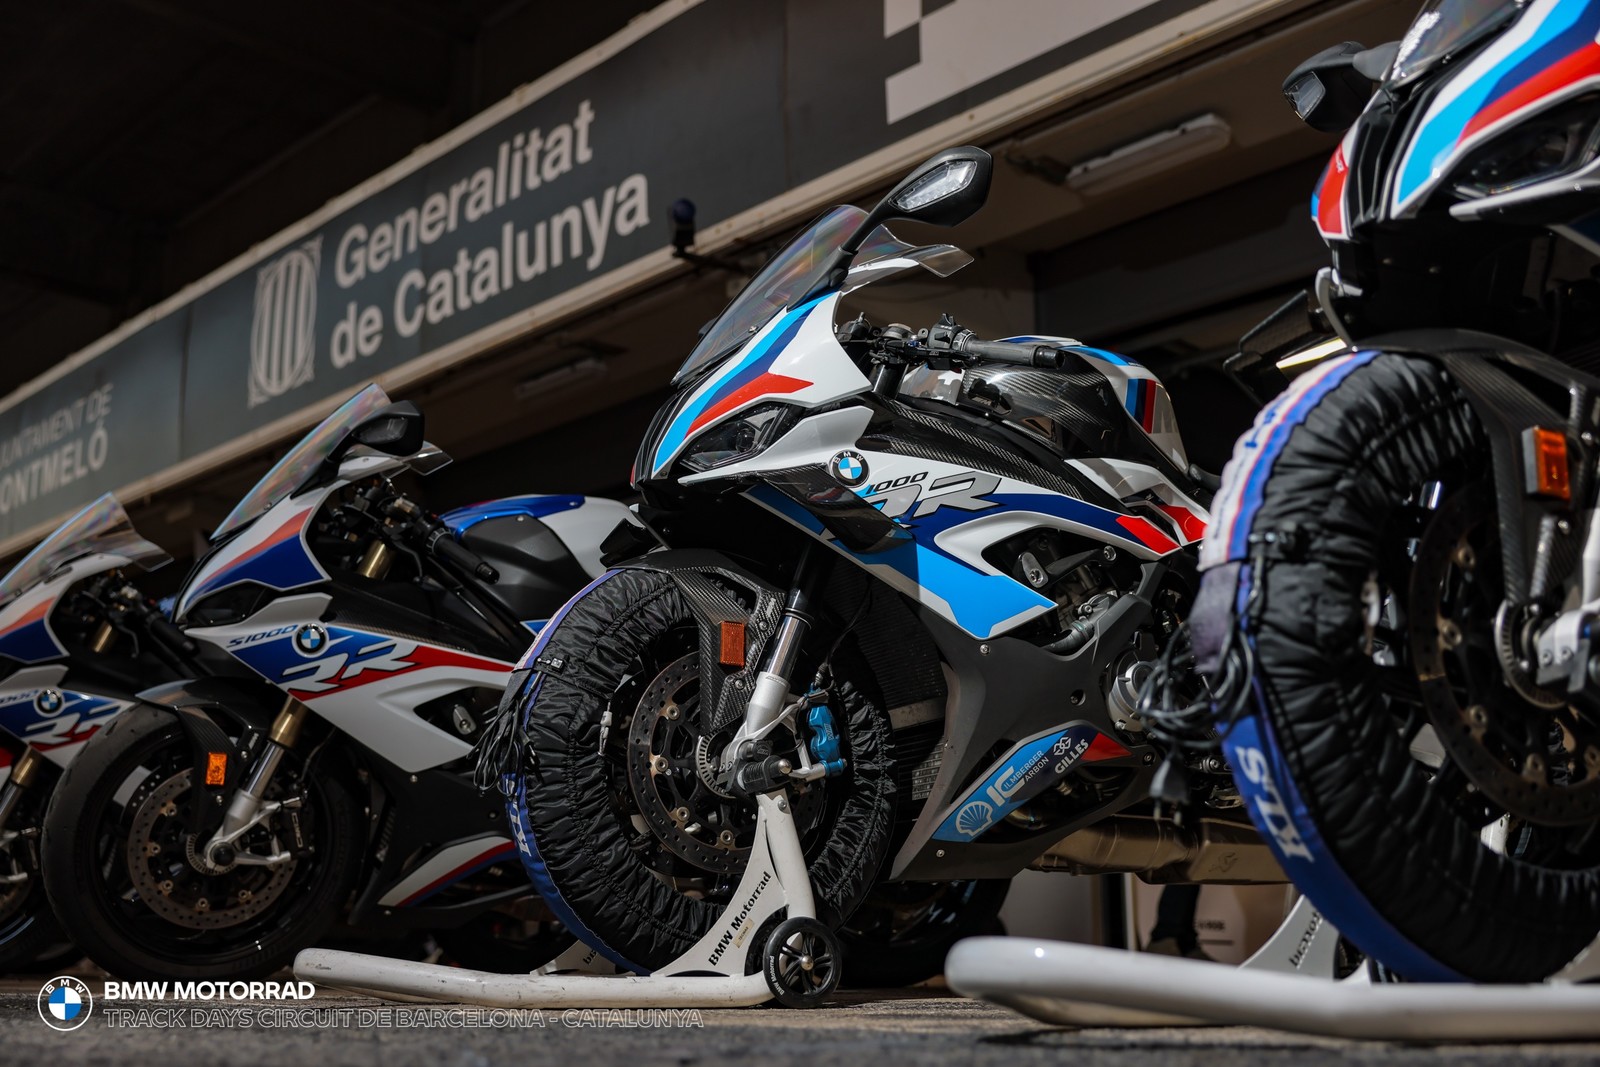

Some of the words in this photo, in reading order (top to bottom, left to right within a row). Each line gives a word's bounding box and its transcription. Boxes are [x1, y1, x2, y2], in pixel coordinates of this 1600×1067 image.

[334, 99, 595, 288] Generalitat
[330, 301, 383, 369] de
[393, 173, 651, 338] Catalunya
[86, 383, 114, 424] DE
[226, 624, 299, 648] S1000
[1003, 750, 1045, 790] ILMBERGER
[1054, 738, 1090, 775] GILLES
[708, 930, 735, 967] BMW
[730, 870, 772, 931] Motorrad
